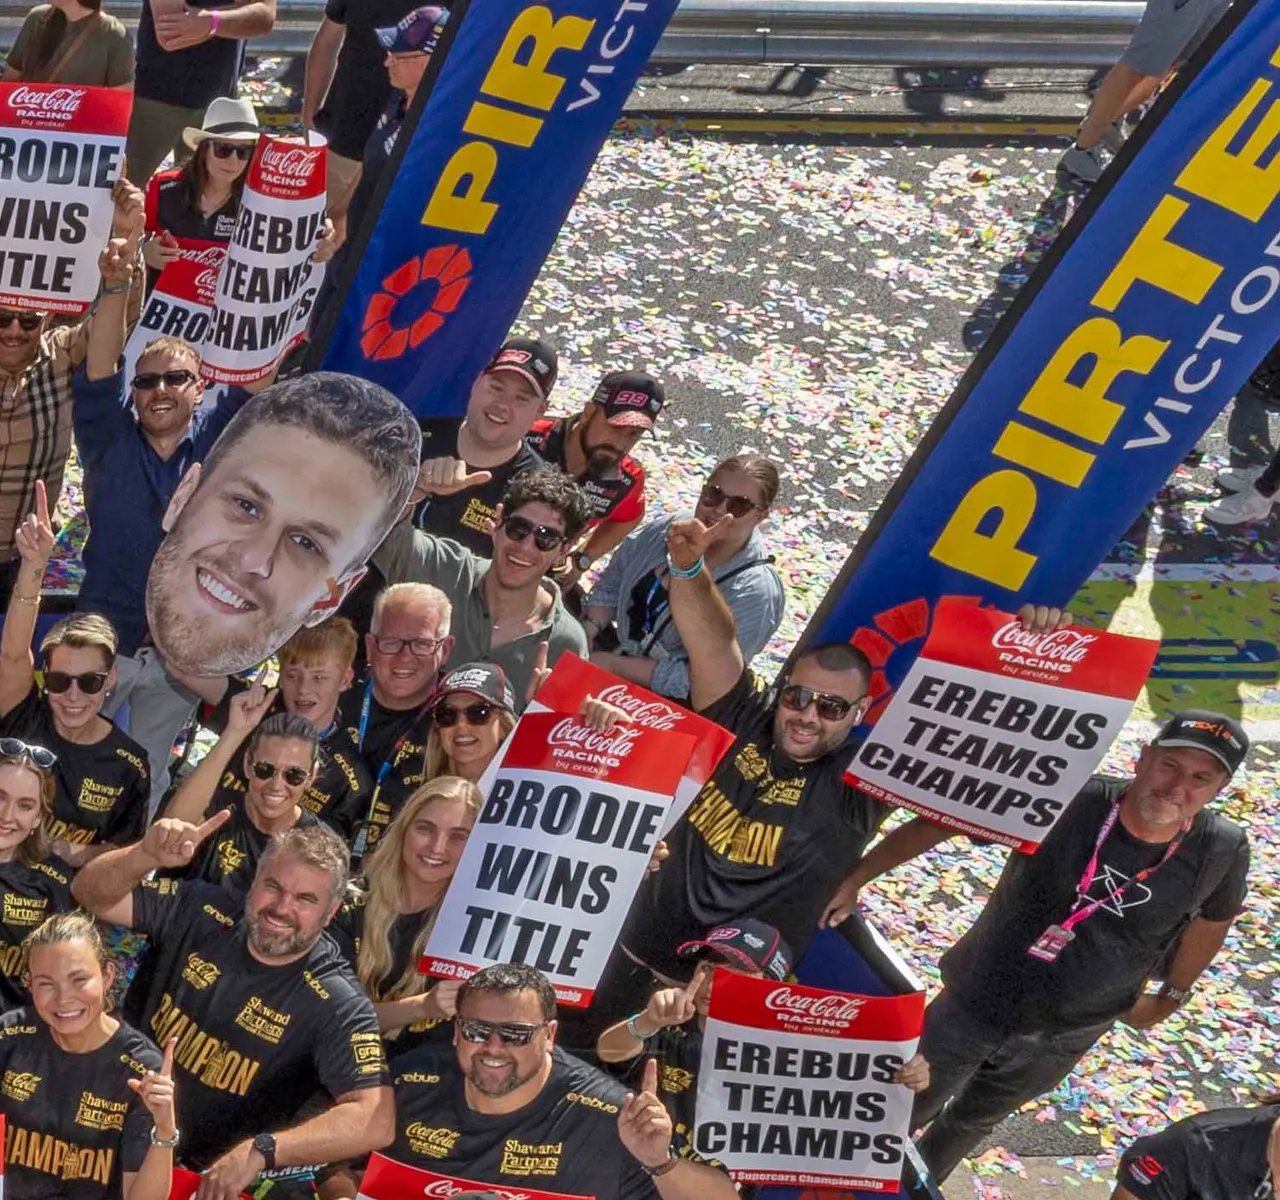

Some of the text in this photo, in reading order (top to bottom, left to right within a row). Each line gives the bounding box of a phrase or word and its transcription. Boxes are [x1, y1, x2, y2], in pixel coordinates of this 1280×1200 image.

[566, 0, 648, 112] VICT
[8, 86, 87, 112] Coca-Cola
[16, 109, 72, 120] RACING
[420, 5, 596, 234] PIR
[260, 173, 308, 187] RACING
[222, 255, 314, 304] TEAMS
[18, 297, 83, 313] Championship
[930, 43, 1280, 592] PIRTE
[992, 621, 1098, 662] Coca-Cola
[999, 652, 1073, 673] RACING
[908, 675, 1108, 751] EREBUS
[548, 717, 643, 757] Coca-Cola
[903, 716, 1068, 787] TEAMS
[552, 748, 620, 768] RACING
[858, 742, 1064, 828] CHAMPS
[479, 779, 665, 855] BRODIE
[939, 814, 1022, 848] Championship
[475, 842, 618, 916] WINS
[458, 906, 591, 978] TITLE
[765, 987, 867, 1021] Coca-Cola
[776, 1013, 850, 1028] RACING
[714, 1037, 904, 1084] EREBUS
[566, 1092, 618, 1114] erebus
[723, 1081, 887, 1123] TEAMS
[502, 1153, 559, 1167] Partners
[505, 1140, 562, 1155] Shawand
[696, 1121, 903, 1165] CHAMPS
[737, 1171, 884, 1189] Supercars Championship
